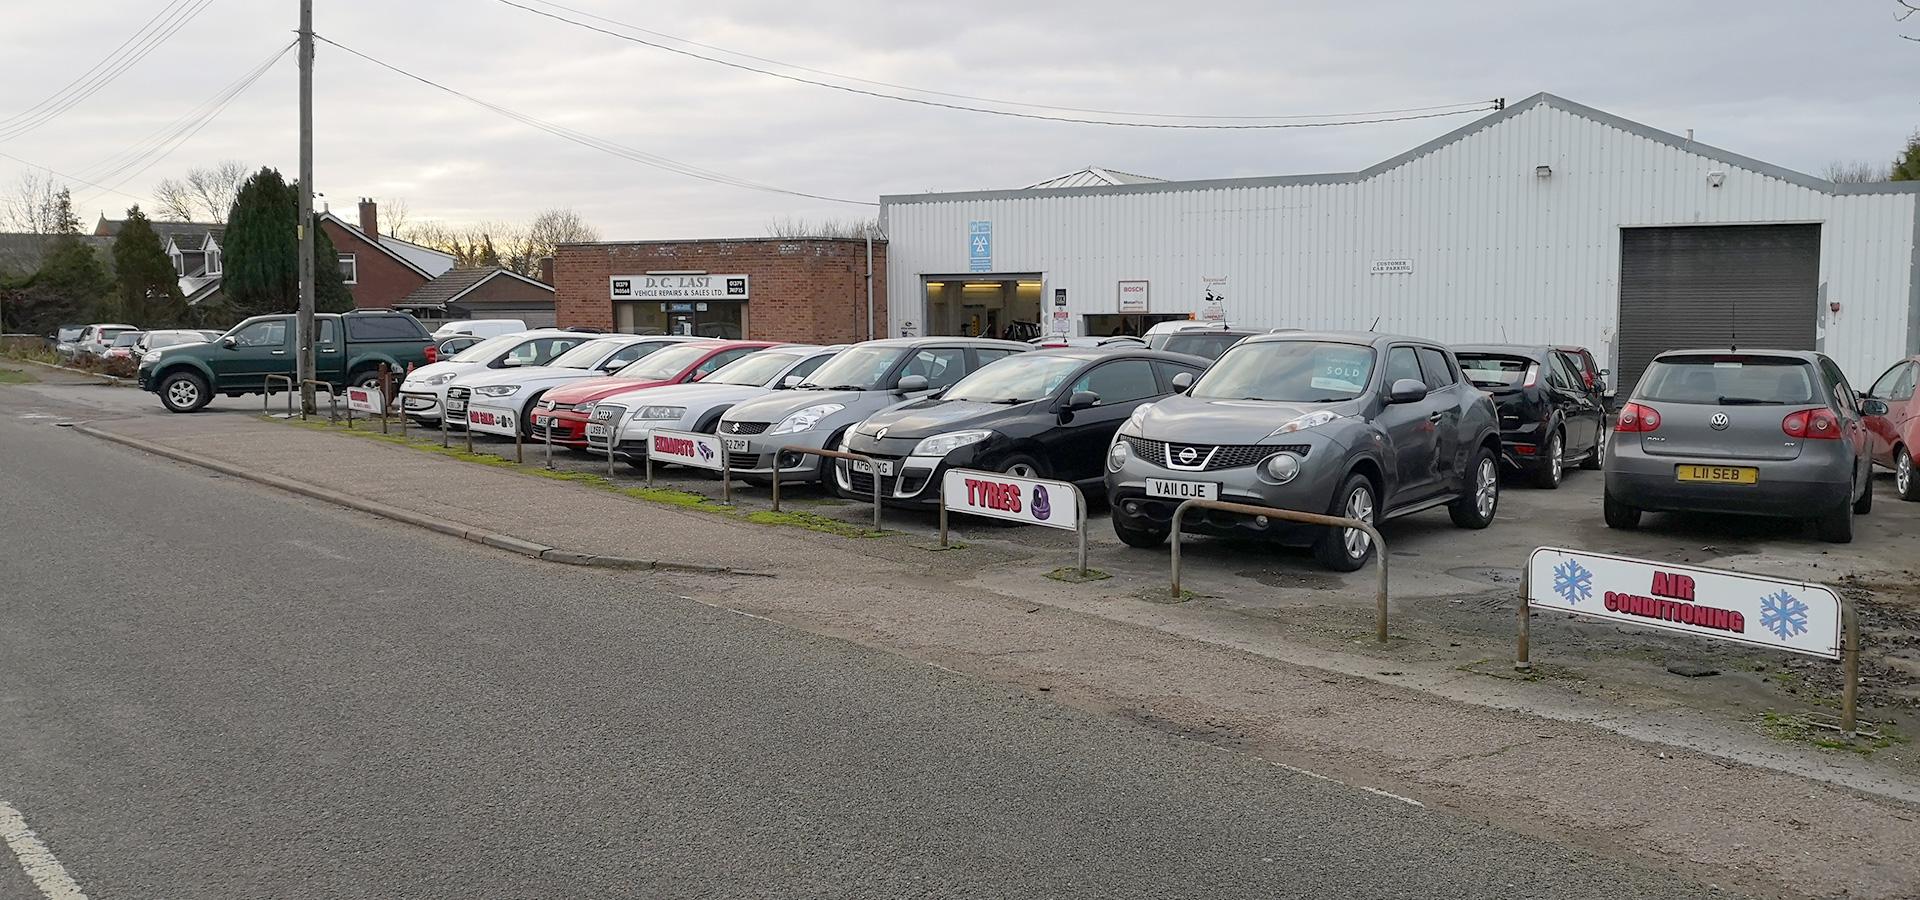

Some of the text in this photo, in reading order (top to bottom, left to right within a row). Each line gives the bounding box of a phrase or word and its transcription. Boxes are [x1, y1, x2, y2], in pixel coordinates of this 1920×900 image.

[678, 277, 712, 288] LAST
[634, 289, 657, 297] VEHICLE
[658, 289, 682, 297] REPAIRS
[1326, 366, 1360, 377] SOLD
[653, 435, 695, 457] EXHAUSTS
[1712, 469, 1740, 480] SEB
[965, 478, 1022, 513] TYRES
[1181, 483, 1206, 498] OJE
[1651, 570, 1696, 602] AIR
[1604, 591, 1745, 634] CONDITIONING
